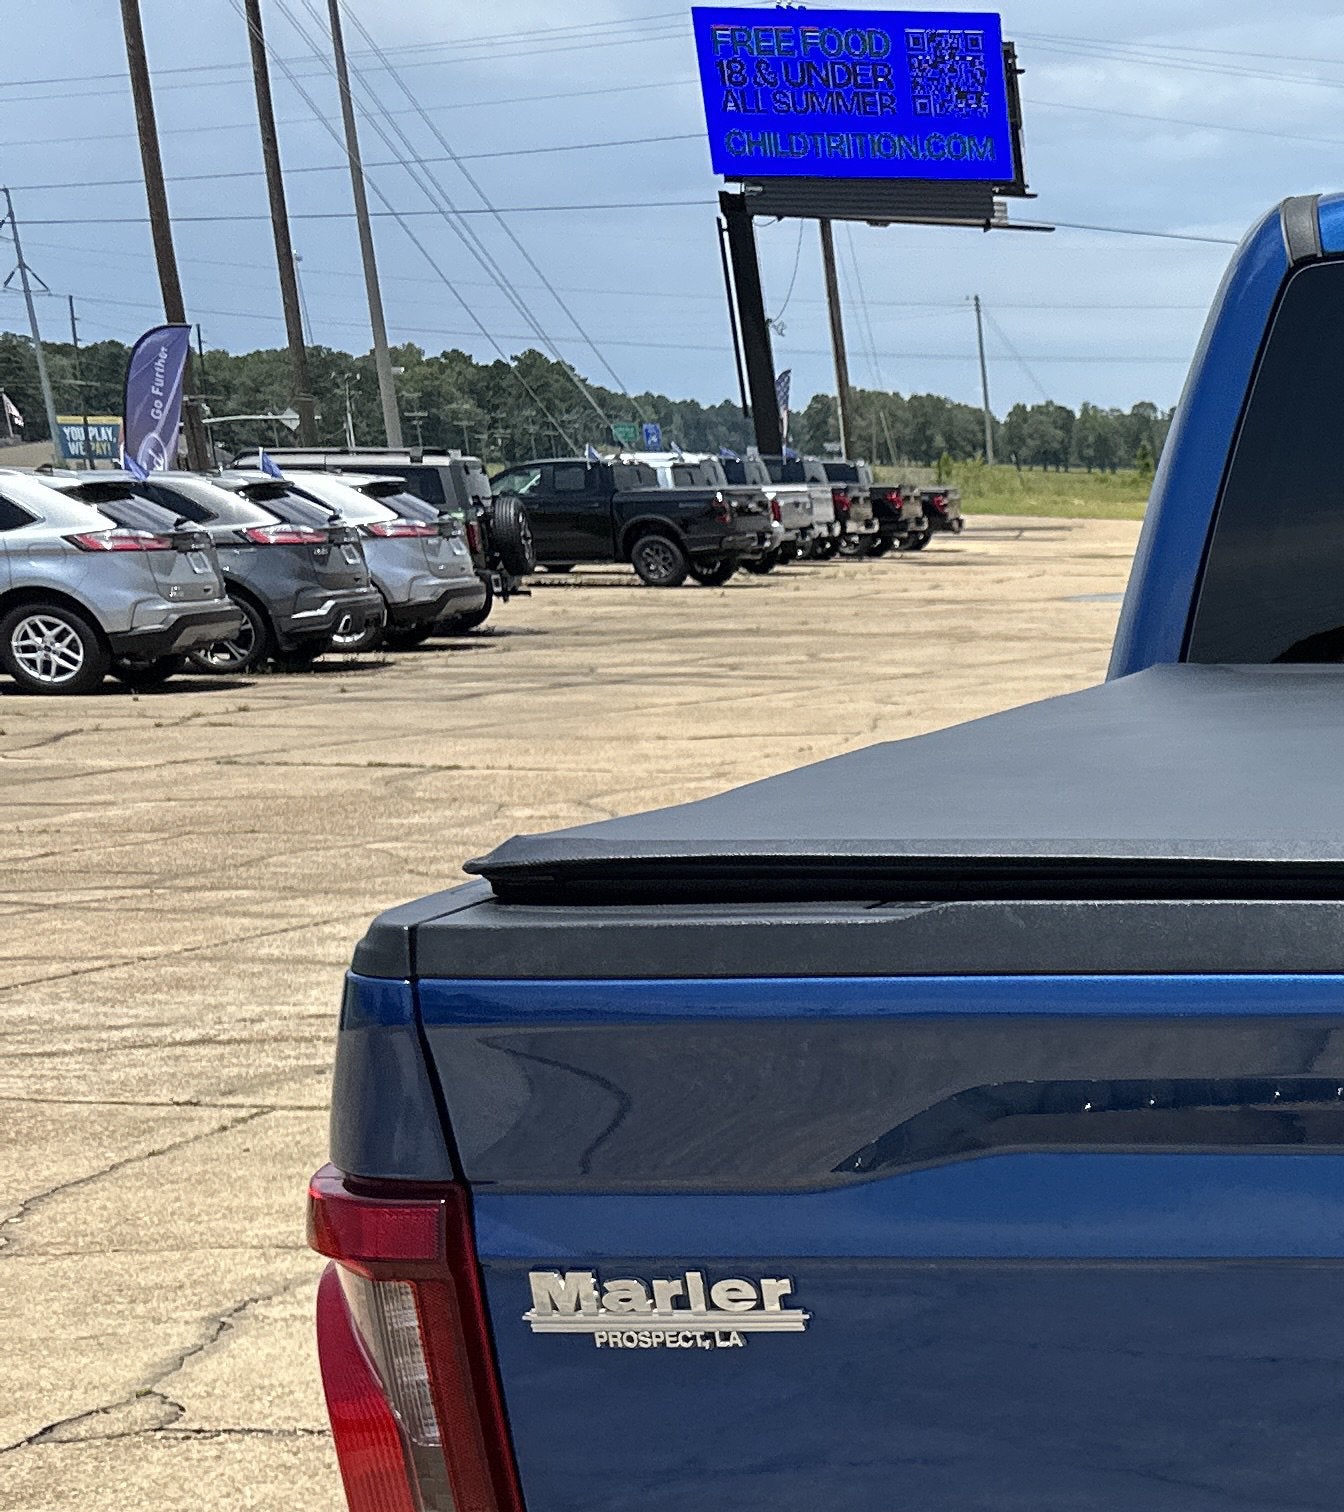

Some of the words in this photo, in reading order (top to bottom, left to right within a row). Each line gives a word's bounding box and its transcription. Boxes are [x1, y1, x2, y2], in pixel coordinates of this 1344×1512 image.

[711, 25, 797, 58] FREE
[800, 26, 891, 59] FOOD
[716, 58, 748, 88] 18
[753, 58, 779, 89] &
[781, 61, 895, 90] UNDER
[722, 90, 769, 114] ALL
[773, 91, 896, 117] SUMMER
[724, 128, 996, 161] CHILDTRITION.COM
[151, 401, 164, 420] Go
[63, 426, 85, 440] YOU
[528, 1271, 793, 1317] Marler
[594, 1331, 711, 1349] PROSPECT,
[714, 1331, 744, 1347] LA
